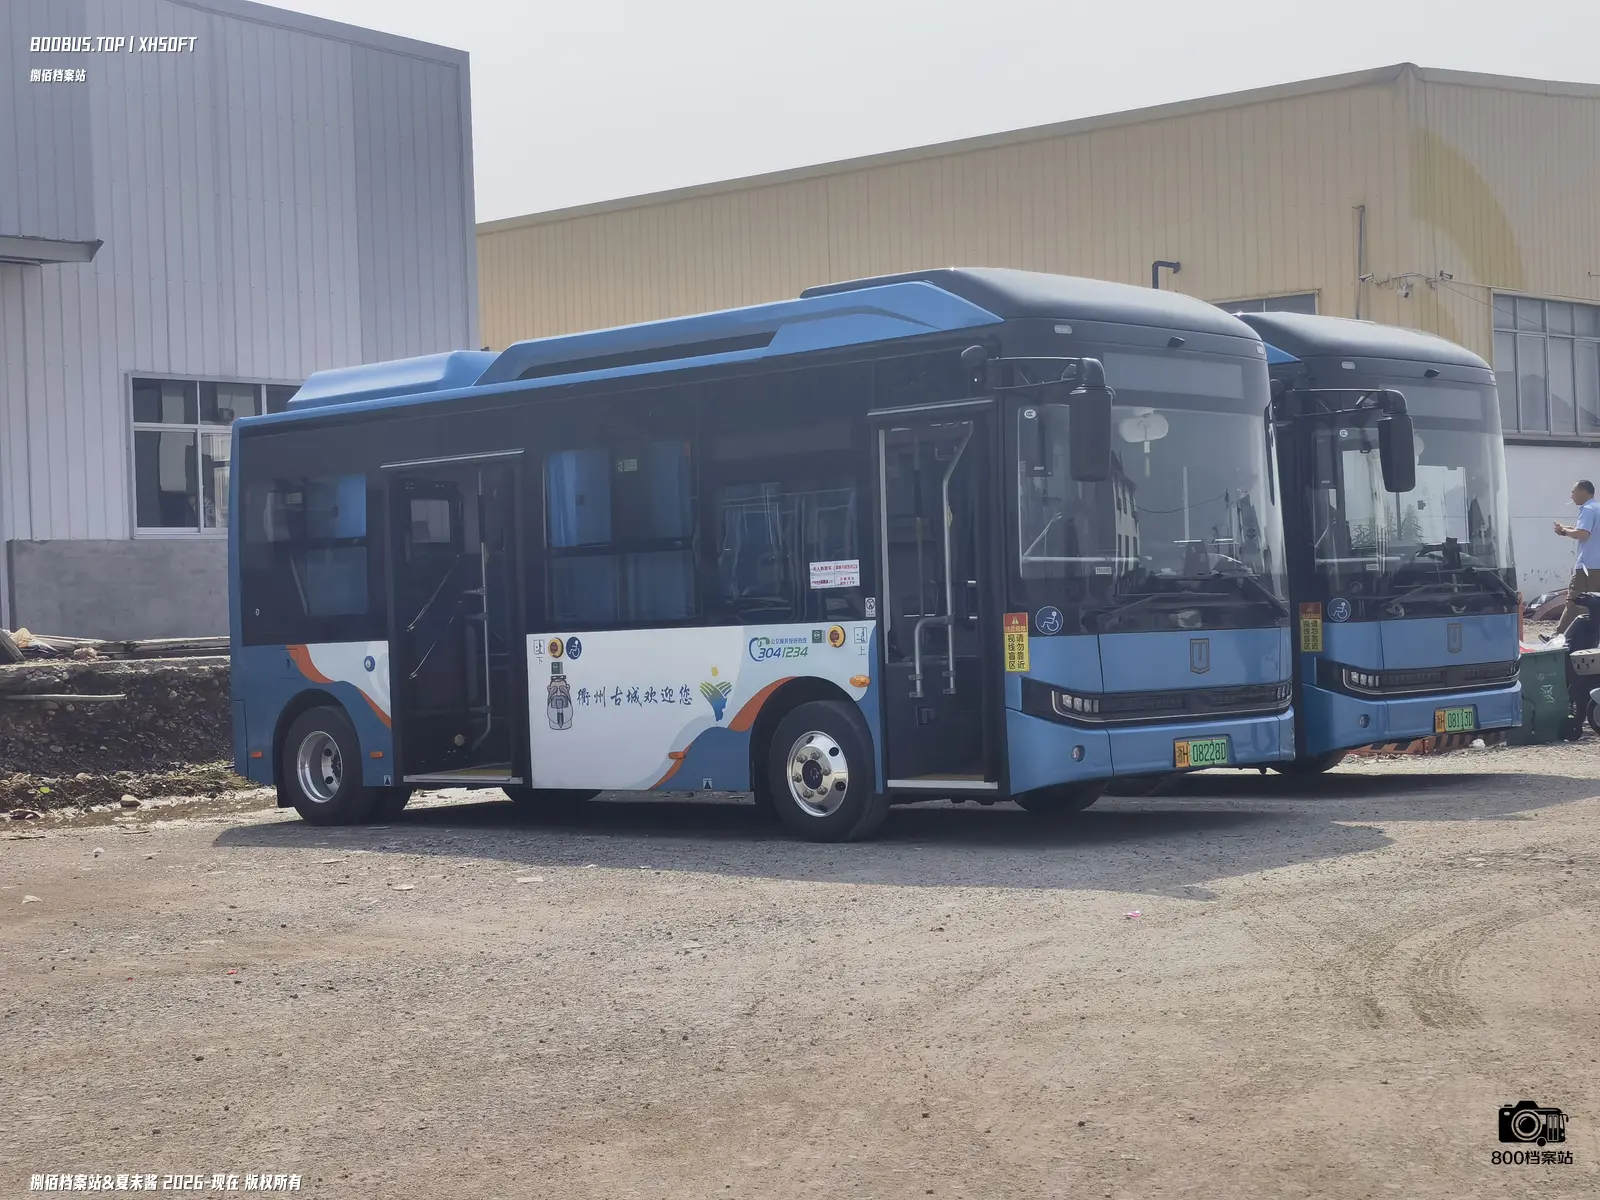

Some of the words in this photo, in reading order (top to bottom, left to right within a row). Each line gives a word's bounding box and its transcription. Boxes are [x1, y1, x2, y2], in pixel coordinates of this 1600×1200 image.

[758, 646, 809, 659] 3041234
[858, 646, 866, 655] 上
[536, 656, 544, 665] 下
[577, 684, 693, 708] 衢州古城欢迎您
